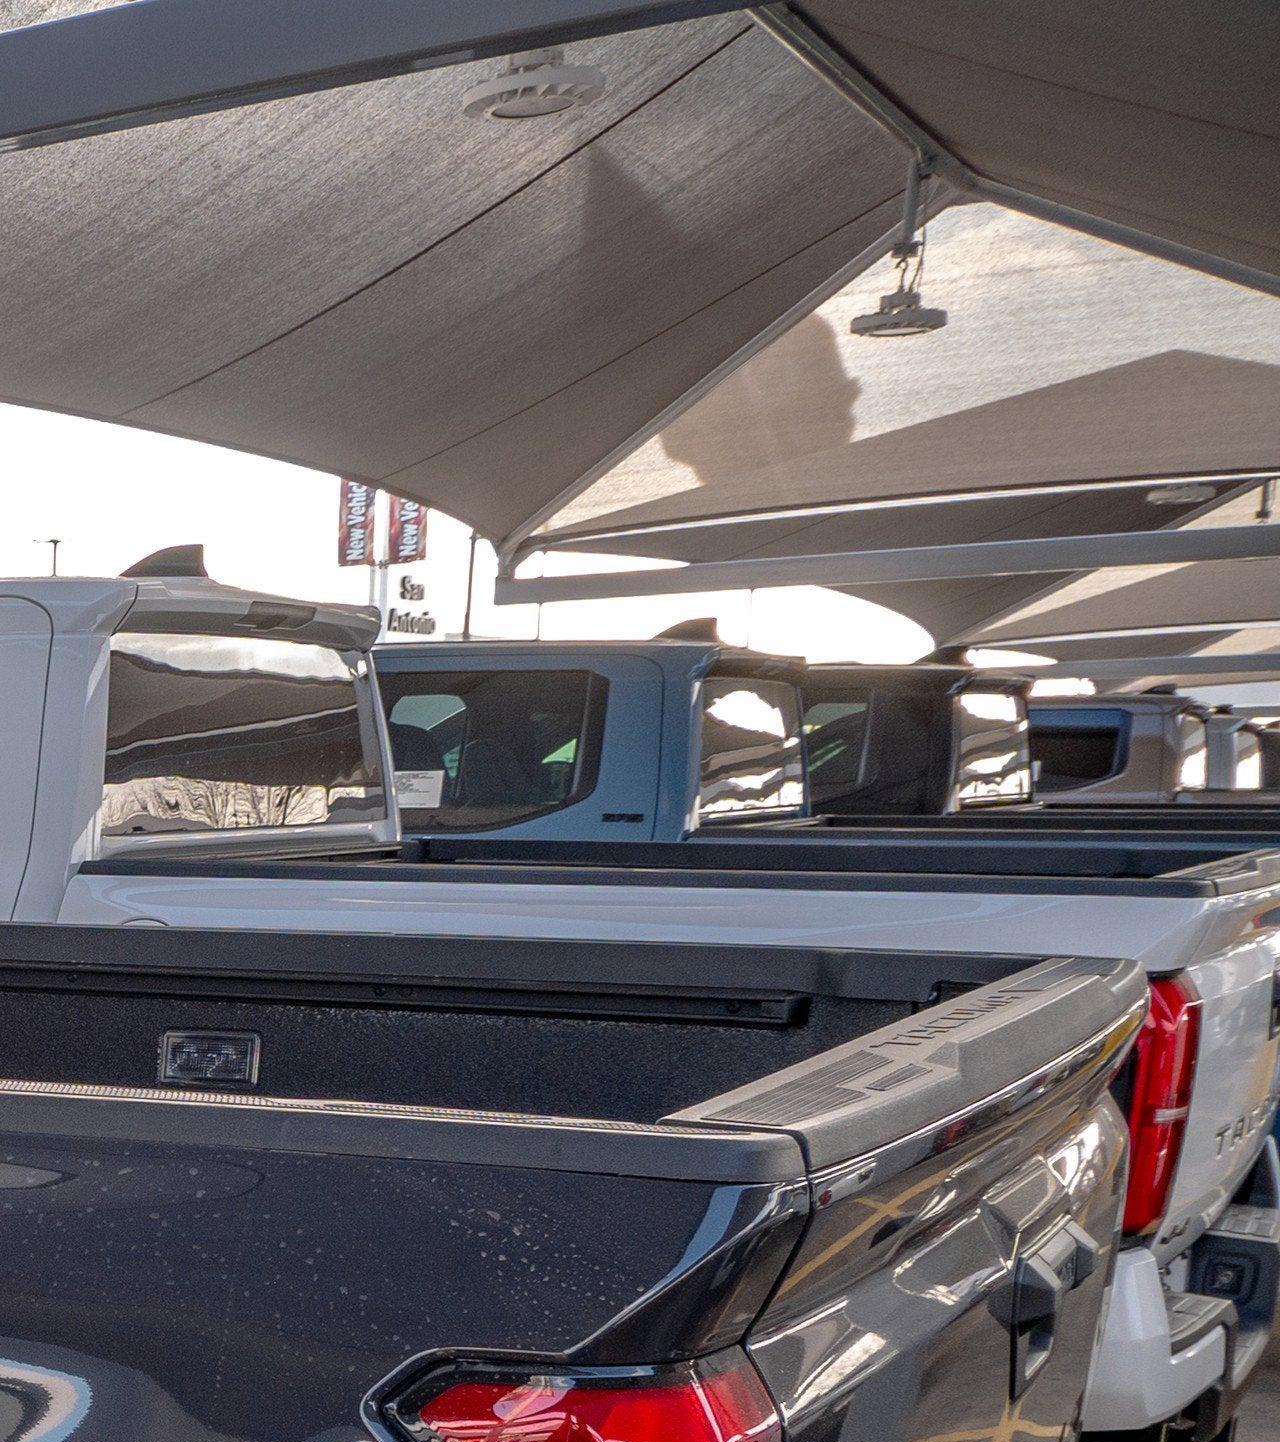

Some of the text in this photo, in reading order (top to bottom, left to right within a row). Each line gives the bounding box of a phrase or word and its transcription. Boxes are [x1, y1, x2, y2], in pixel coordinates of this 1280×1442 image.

[345, 527, 367, 561] New
[398, 525, 418, 556] New
[400, 575, 425, 601] San
[387, 608, 437, 635] Antonio
[869, 994, 1024, 1049] TACOMA
